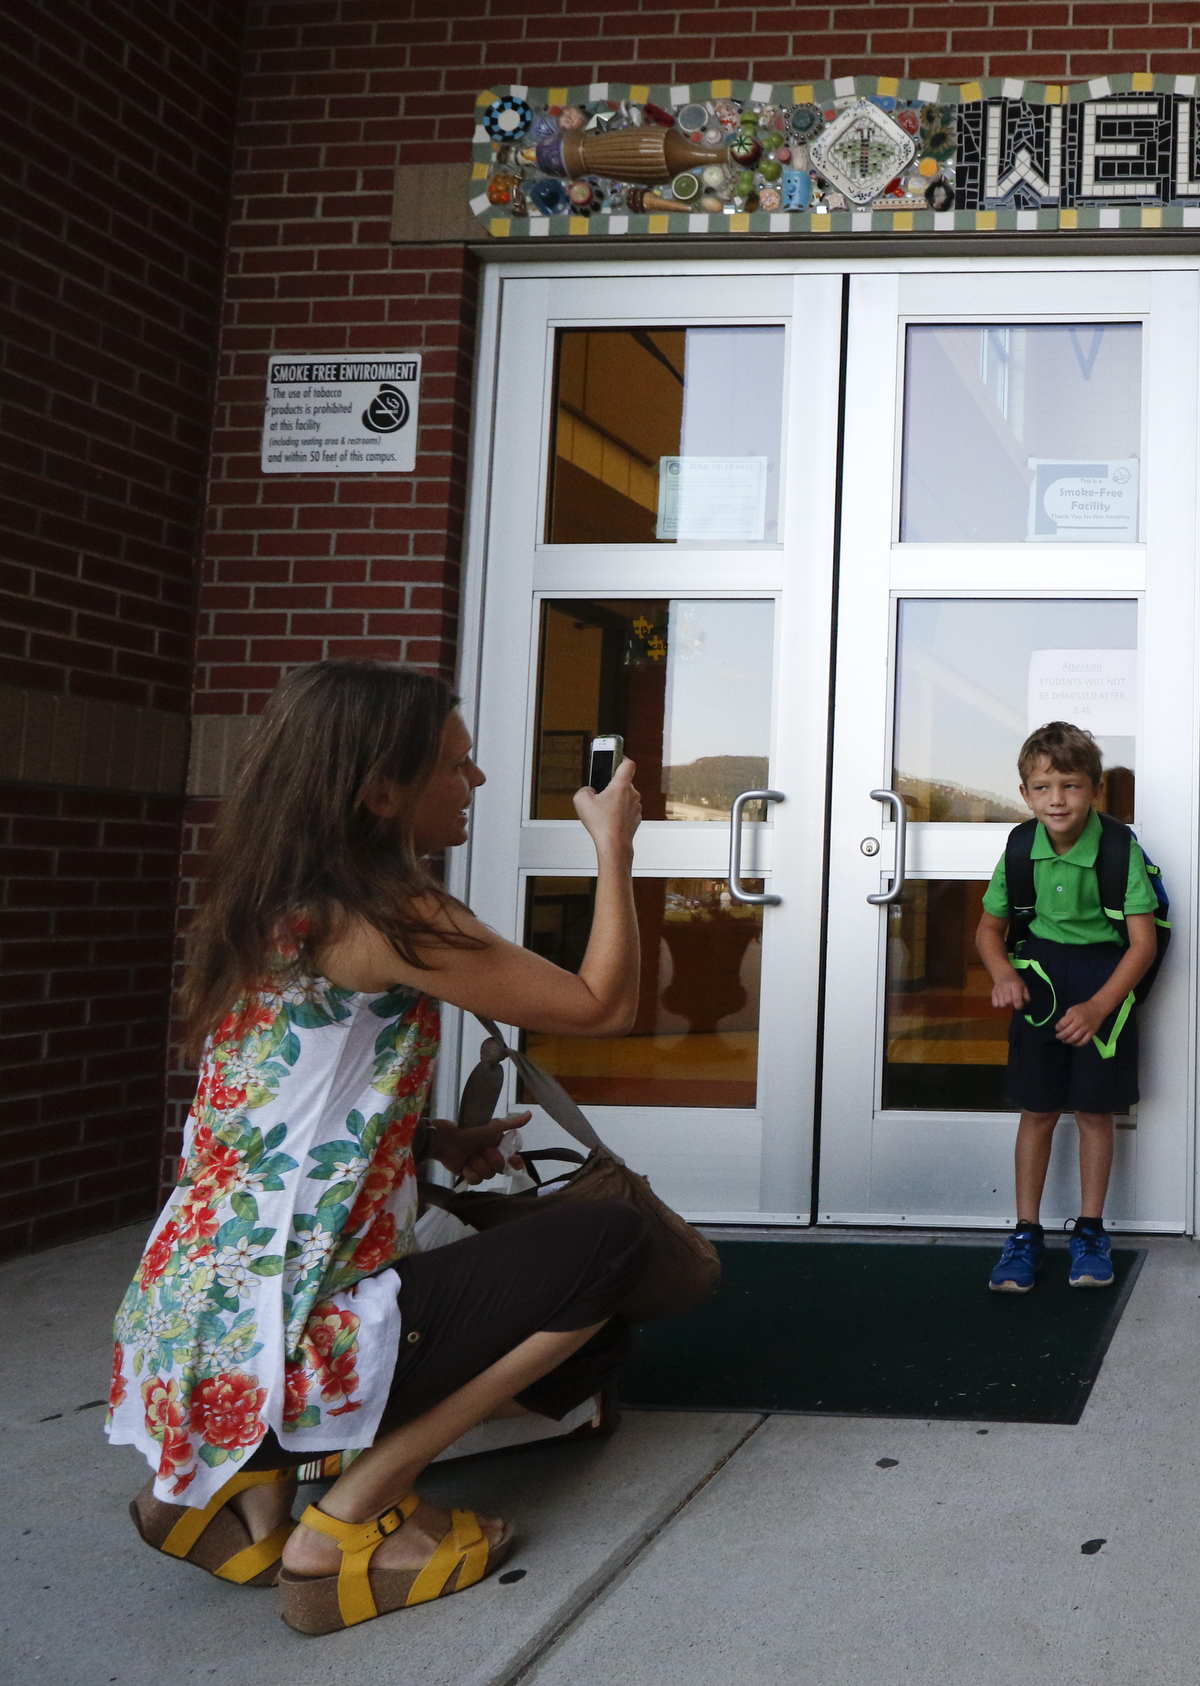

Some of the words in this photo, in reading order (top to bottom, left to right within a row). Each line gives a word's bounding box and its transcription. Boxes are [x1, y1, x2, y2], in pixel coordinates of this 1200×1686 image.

[273, 365, 311, 382] SMOKE
[312, 364, 337, 381] FREE
[339, 363, 416, 381] ENVIRONMENT
[272, 387, 288, 399] The
[288, 390, 301, 398] use
[303, 386, 312, 398] of
[313, 387, 342, 398] tobacco
[271, 404, 303, 417] products
[305, 403, 312, 414] is
[313, 403, 352, 416] prohibited
[270, 421, 278, 431] at
[280, 420, 293, 431] this
[295, 419, 321, 433] facility
[268, 437, 299, 448] (including
[300, 437, 323, 448] seating
[324, 438, 340, 446] area
[341, 437, 346, 445] &
[347, 436, 382, 446] restrooms)
[268, 452, 282, 463] and
[284, 451, 307, 462] within
[309, 451, 320, 462] 50
[322, 450, 338, 462] feet
[339, 450, 348, 462] of
[350, 450, 363, 461] this
[365, 452, 397, 464] campus.
[1059, 487, 1123, 498] Smoke-Free
[1071, 501, 1111, 512] Facility
[1062, 662, 1102, 671] Attention
[1039, 678, 1083, 686] STUDENTS
[1085, 678, 1105, 686] WILL
[1107, 678, 1126, 686] NOT
[1039, 692, 1049, 700] BE
[1051, 692, 1097, 700] DISMISSED
[1099, 692, 1125, 700] AFTER
[1073, 706, 1091, 714] 2:45
